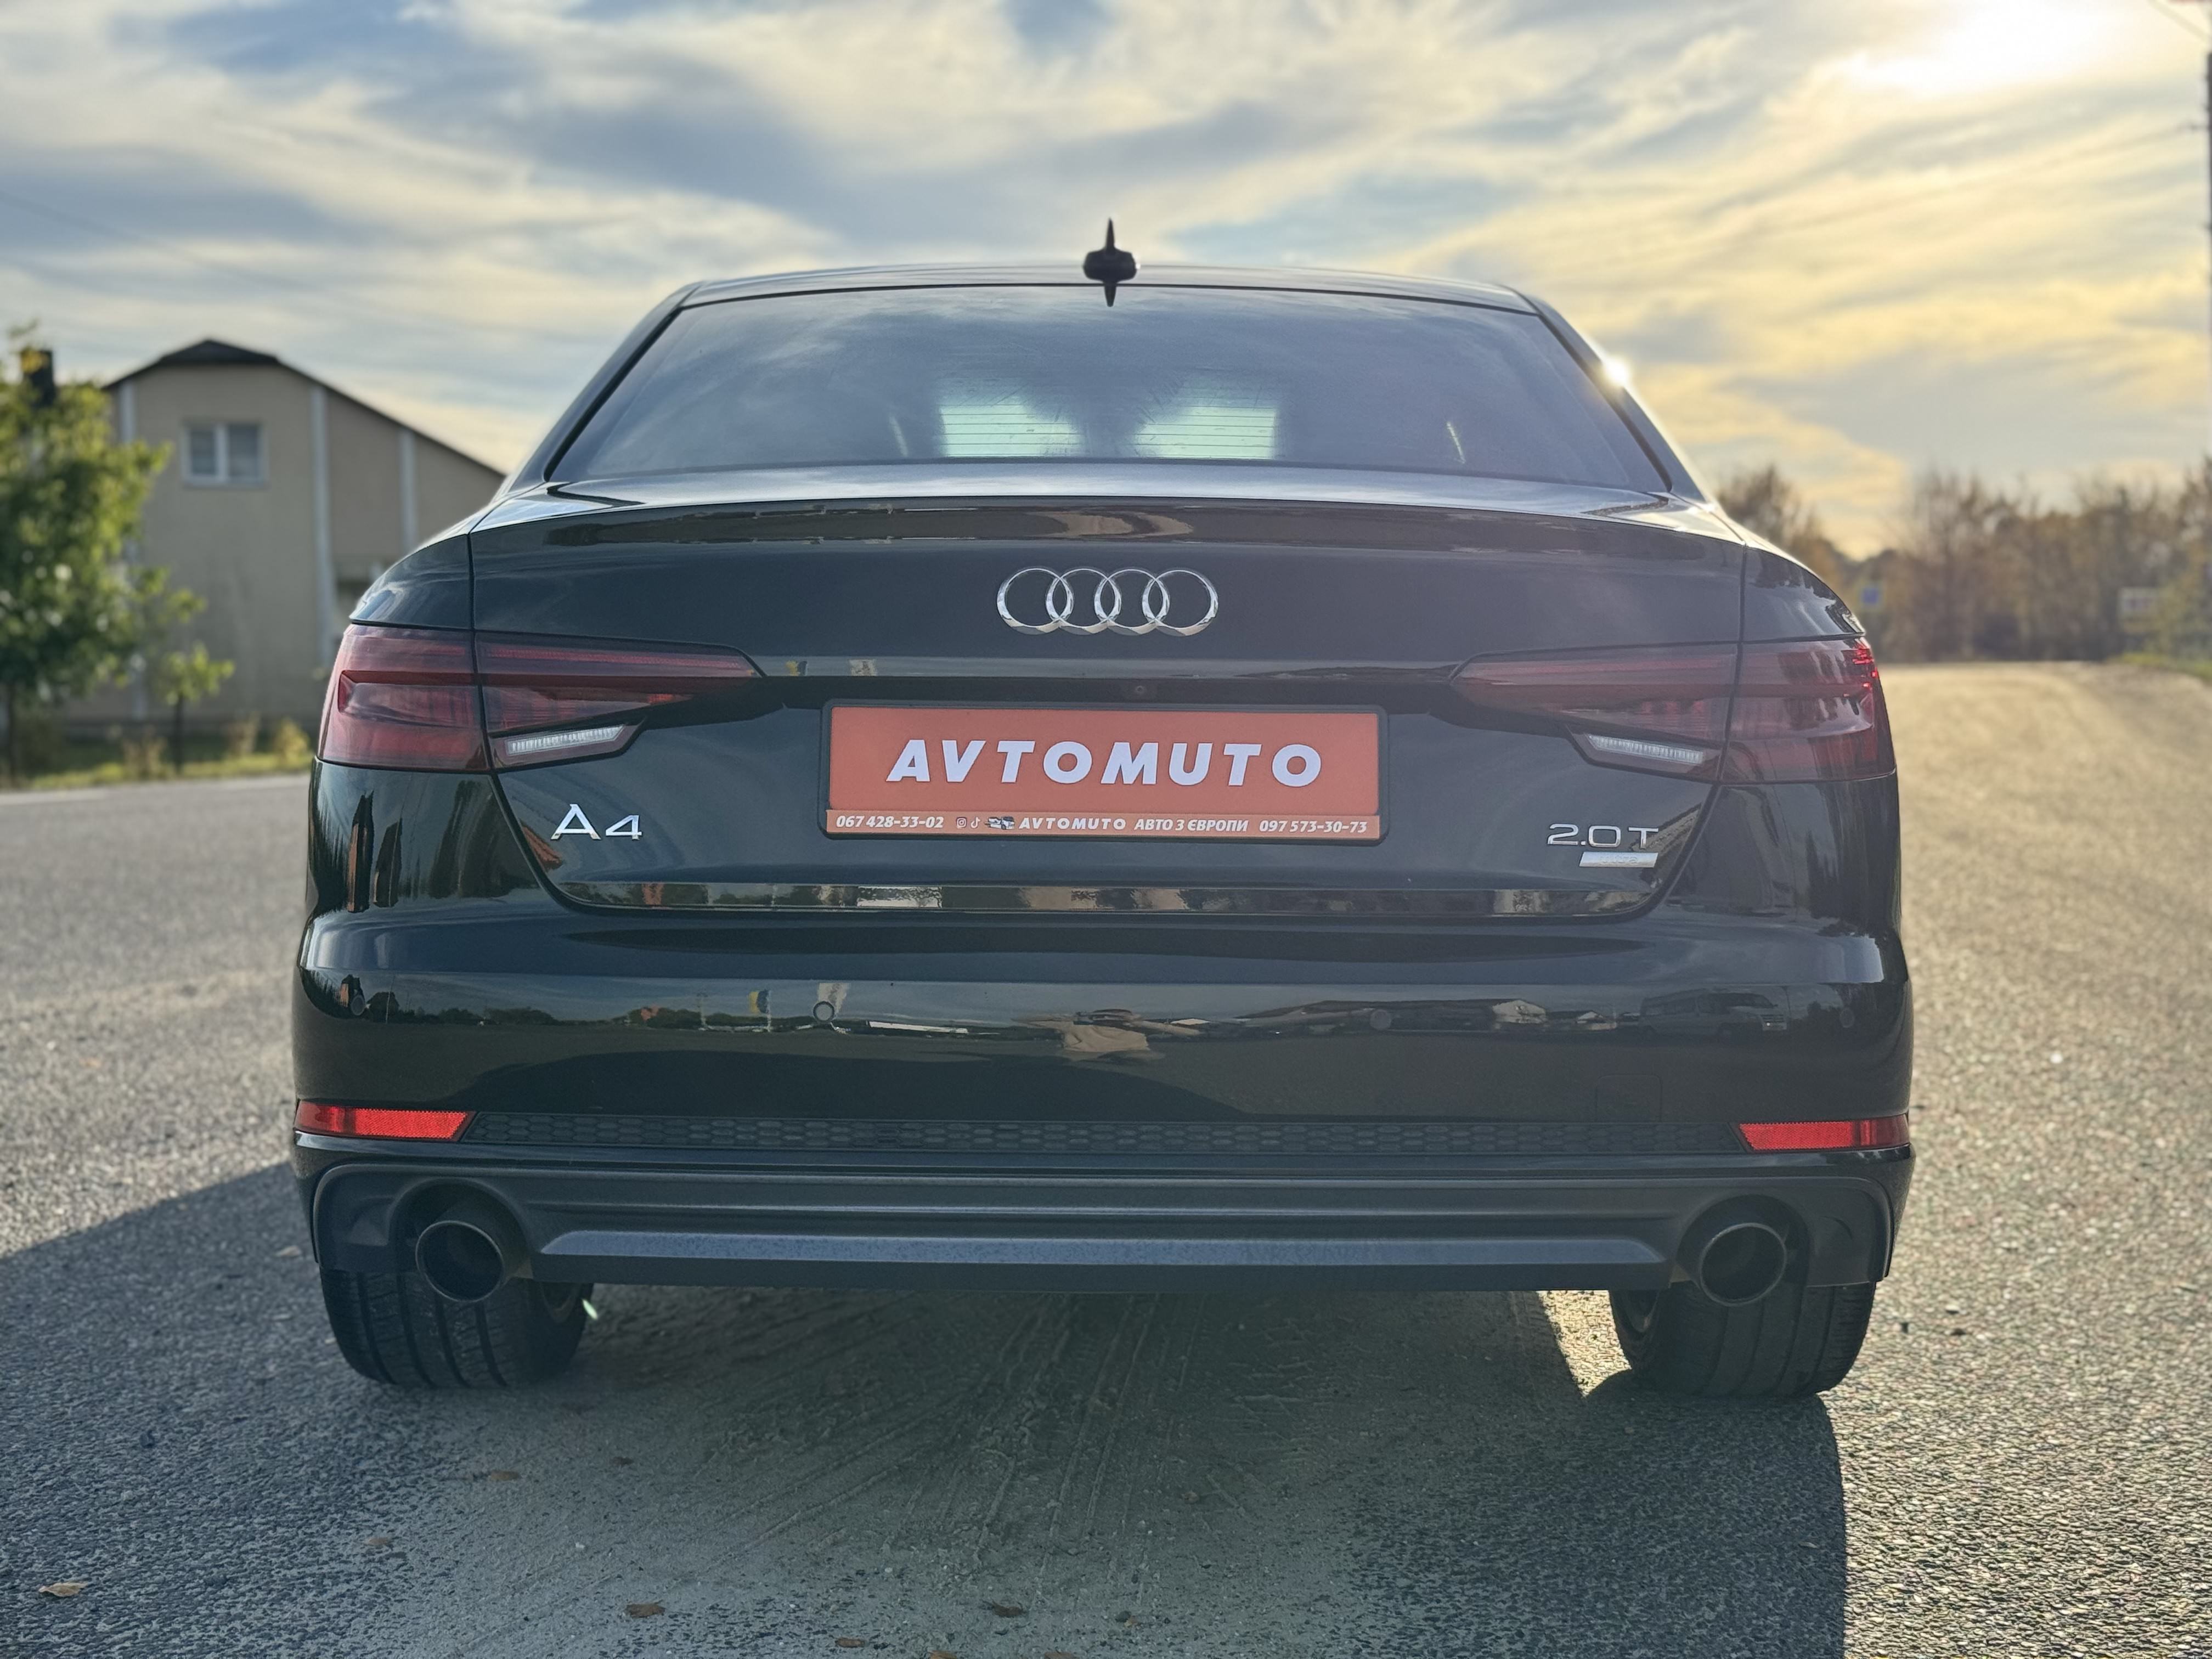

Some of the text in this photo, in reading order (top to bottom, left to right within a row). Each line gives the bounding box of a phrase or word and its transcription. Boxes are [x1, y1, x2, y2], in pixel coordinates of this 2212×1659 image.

[885, 739, 1321, 787] AVTOMUTO
[550, 803, 642, 840] A4
[836, 815, 865, 828] 067
[866, 815, 945, 828] 428-33-02
[1019, 817, 1126, 830] AVTOMUTO
[1134, 818, 1173, 831] АВТО
[1187, 819, 1249, 832] ЄВРОПИ
[1259, 820, 1288, 832] 097
[1289, 820, 1368, 833] 573-30-73
